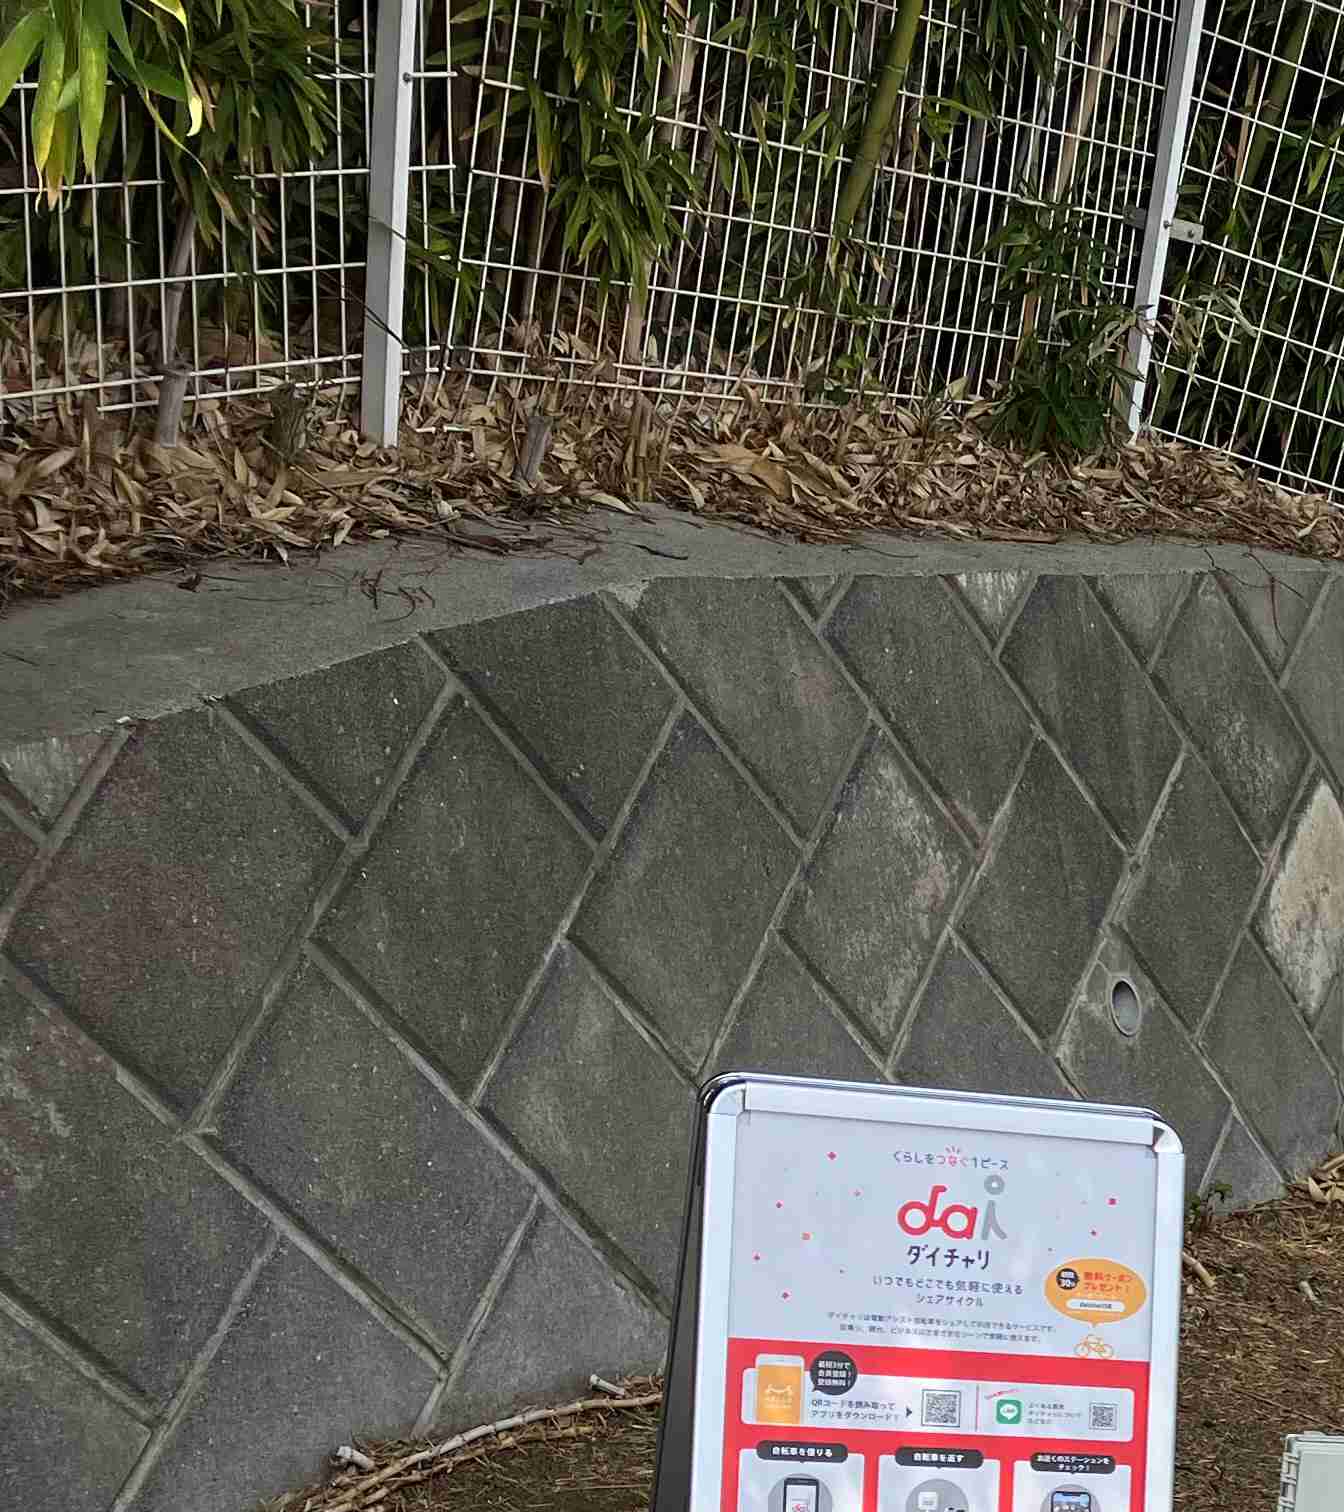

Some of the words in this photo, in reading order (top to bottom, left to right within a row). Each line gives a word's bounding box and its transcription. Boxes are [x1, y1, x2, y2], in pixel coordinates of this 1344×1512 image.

[907, 1244, 991, 1271] ダイチャリ
[872, 1275, 1024, 1296] いつでもどこでも気軽に使える
[916, 1294, 985, 1308] シェアサイクル
